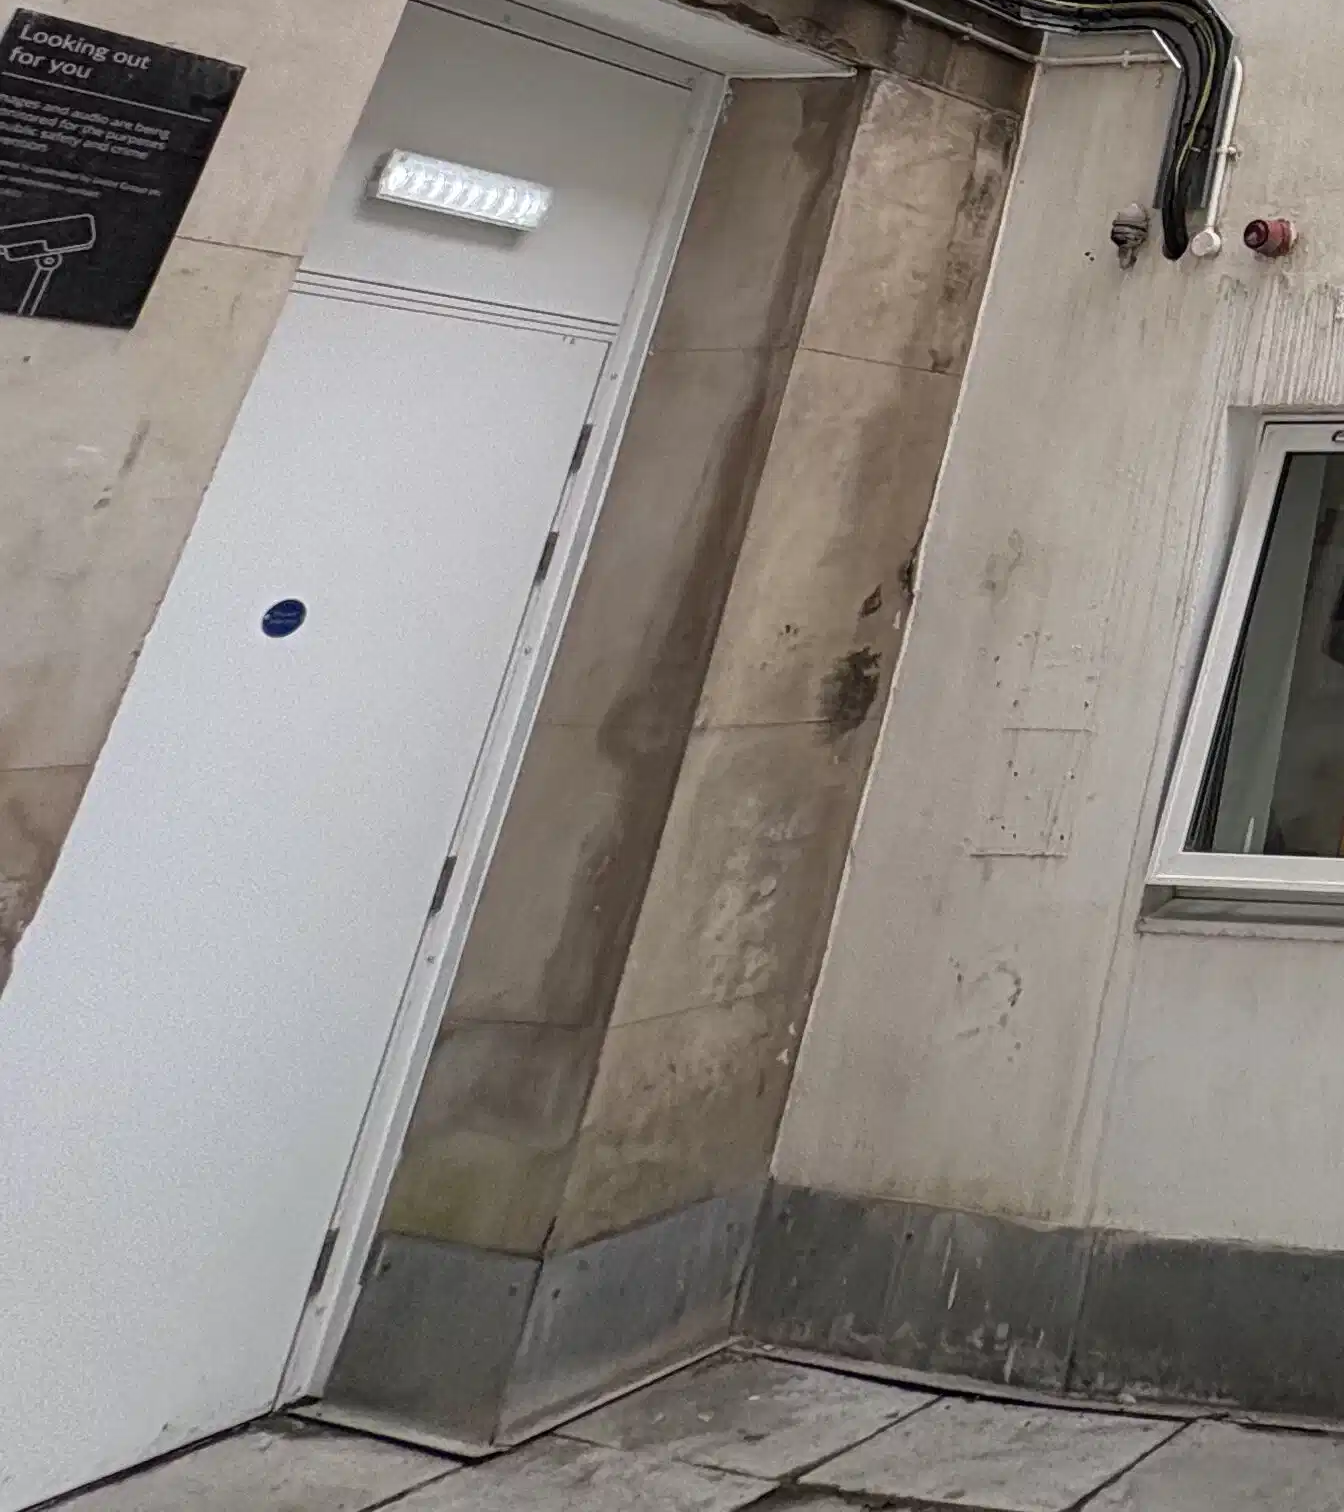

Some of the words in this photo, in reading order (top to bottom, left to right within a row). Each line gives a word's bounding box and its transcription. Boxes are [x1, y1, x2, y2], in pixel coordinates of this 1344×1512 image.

[8, 46, 46, 67] for
[48, 59, 92, 79] you
[18, 23, 110, 62] Looking
[113, 51, 151, 70] out
